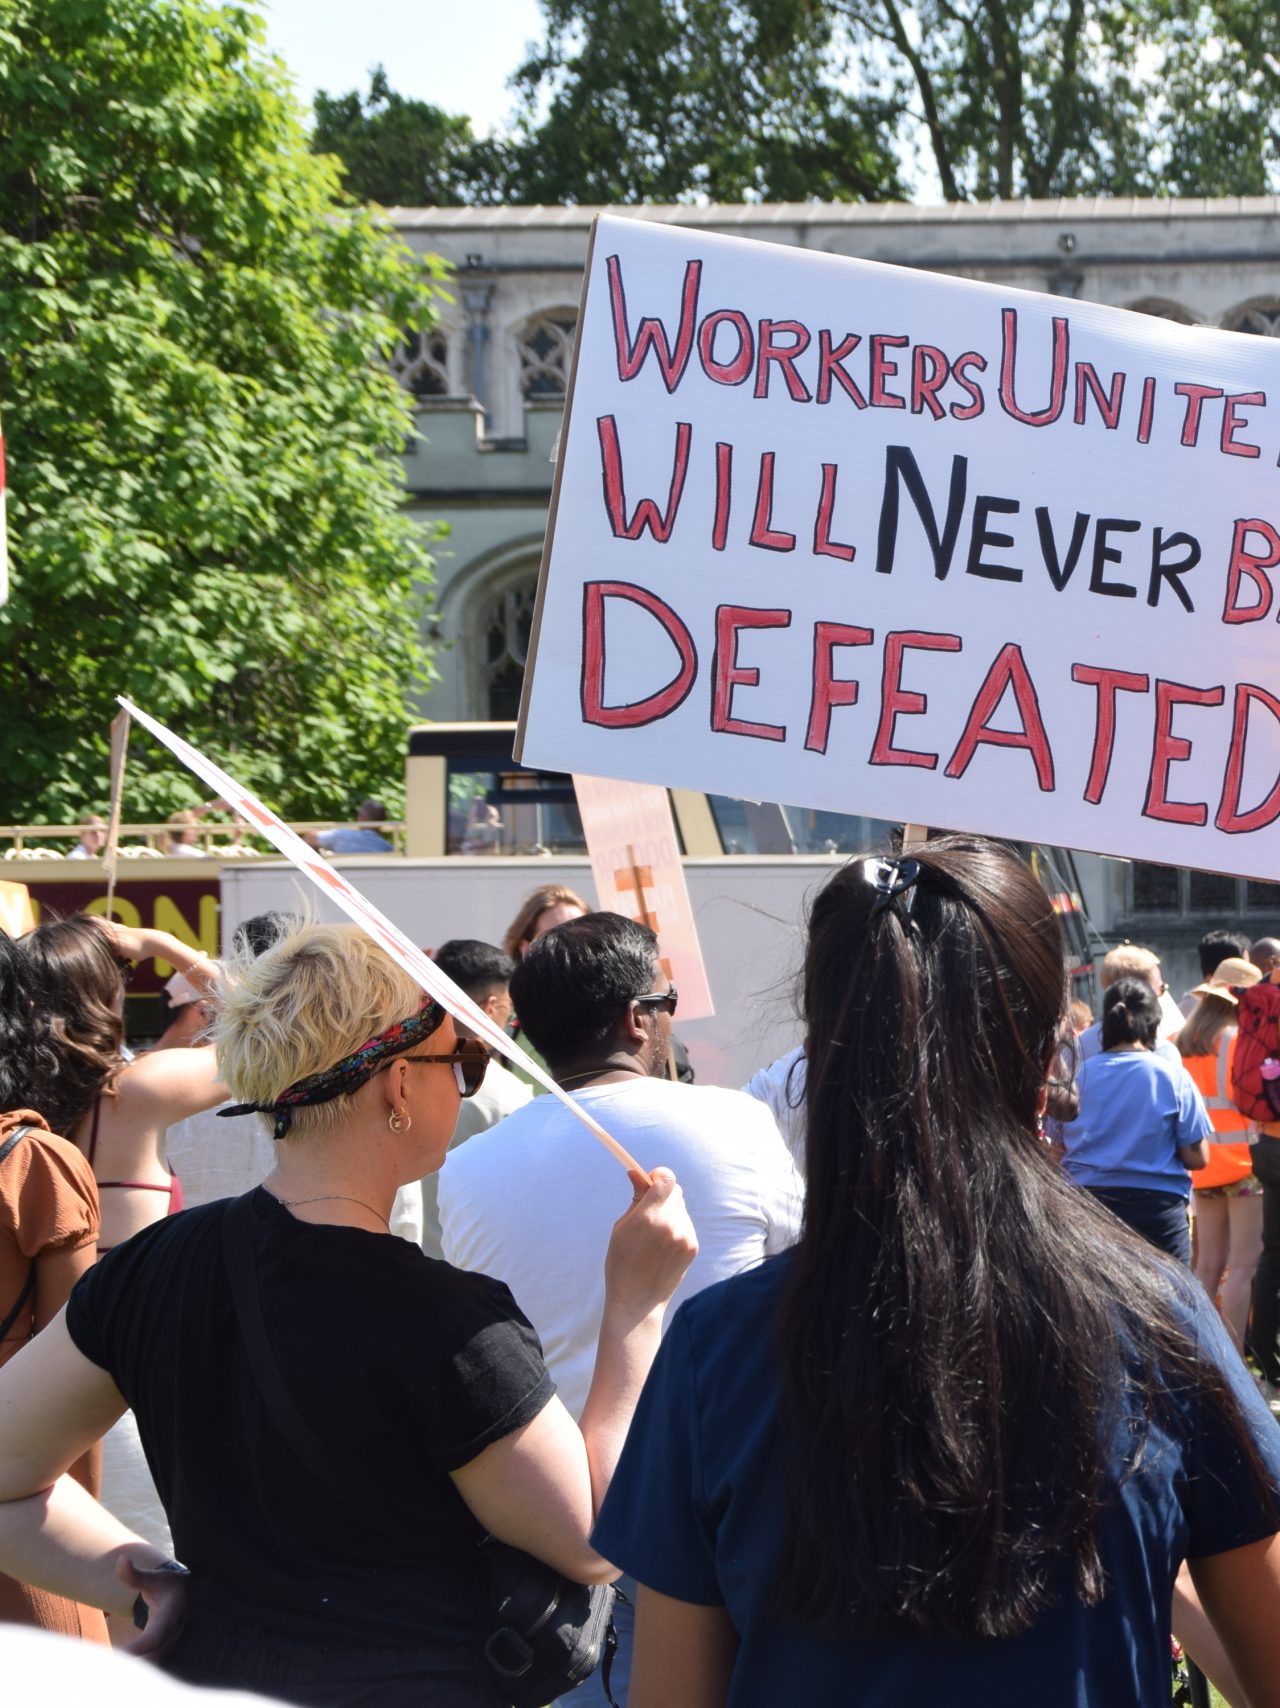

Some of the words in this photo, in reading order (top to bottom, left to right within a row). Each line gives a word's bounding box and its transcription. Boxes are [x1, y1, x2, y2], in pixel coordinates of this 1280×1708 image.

[606, 254, 988, 420] WORKERS
[596, 414, 857, 563] WILL
[875, 444, 1202, 613] NEVER
